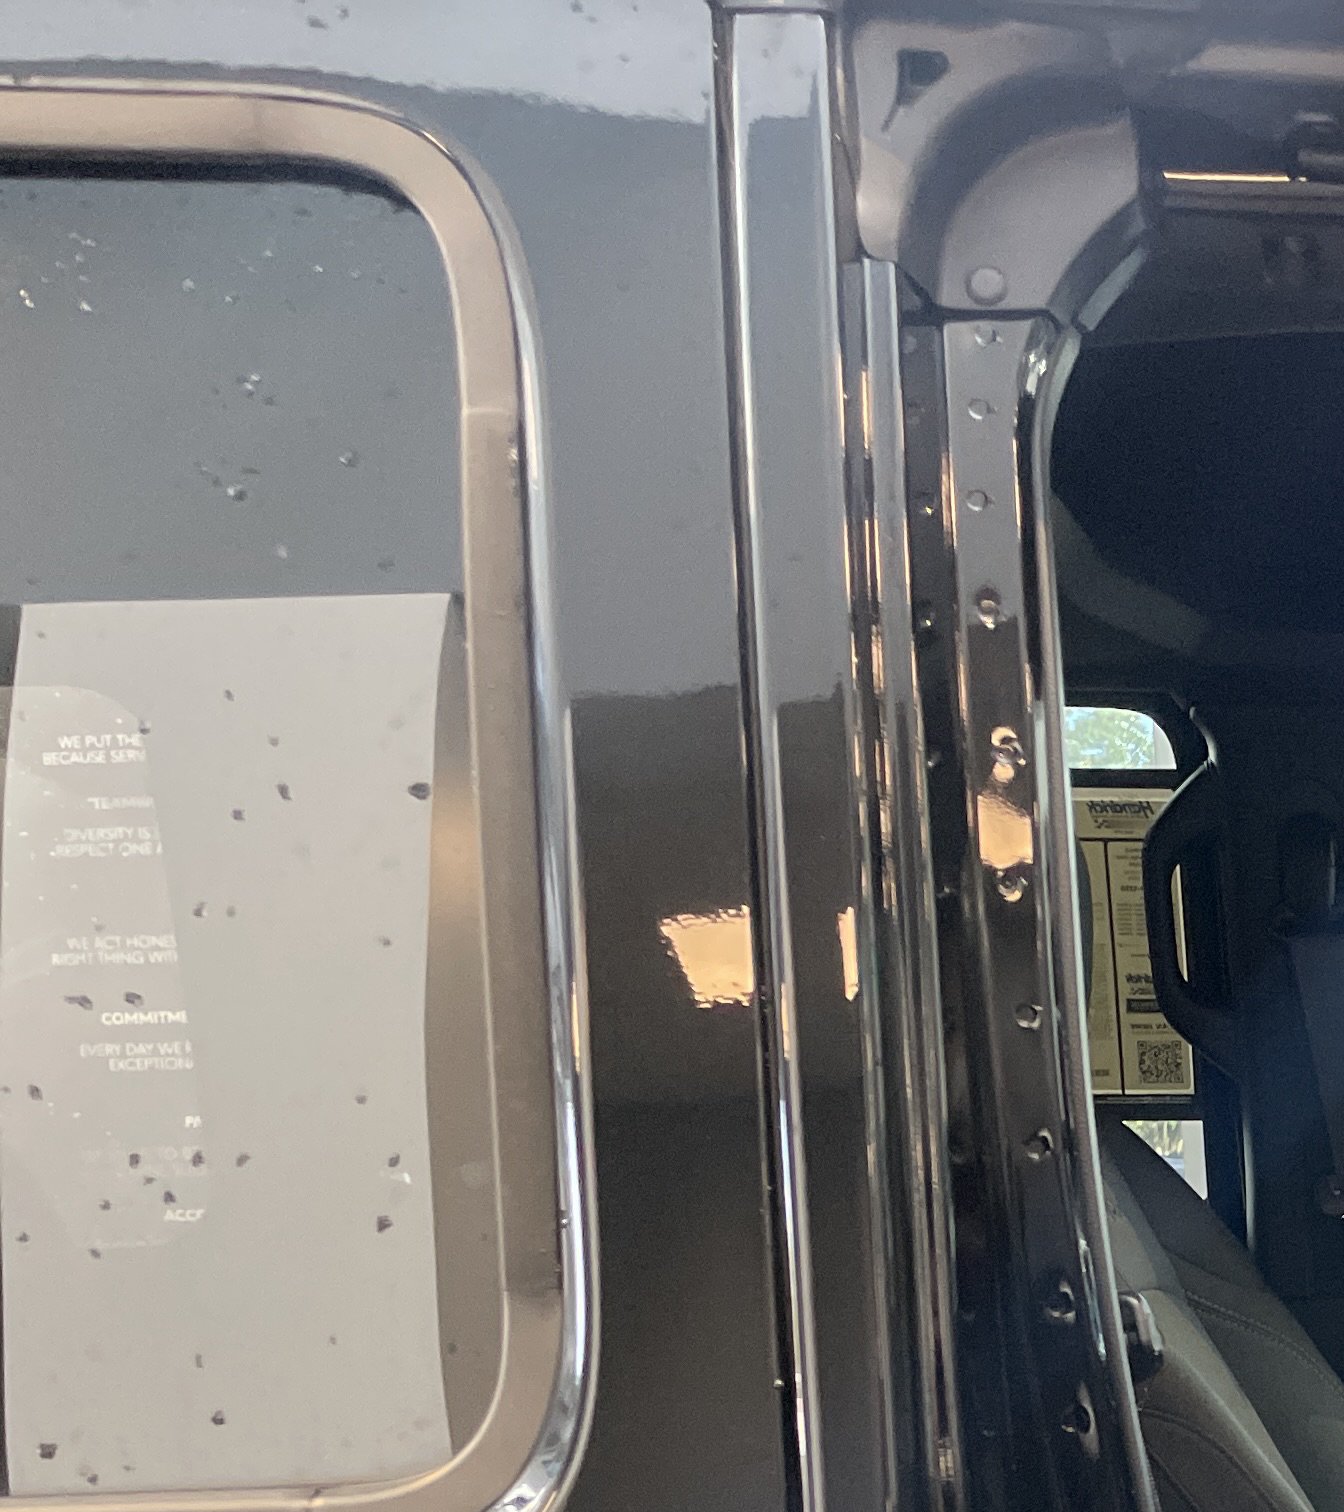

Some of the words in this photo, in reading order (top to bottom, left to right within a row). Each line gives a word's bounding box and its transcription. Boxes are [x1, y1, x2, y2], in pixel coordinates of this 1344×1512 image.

[58, 735, 81, 749] WE
[85, 735, 112, 748] PUT
[42, 750, 106, 766] BECAUSE
